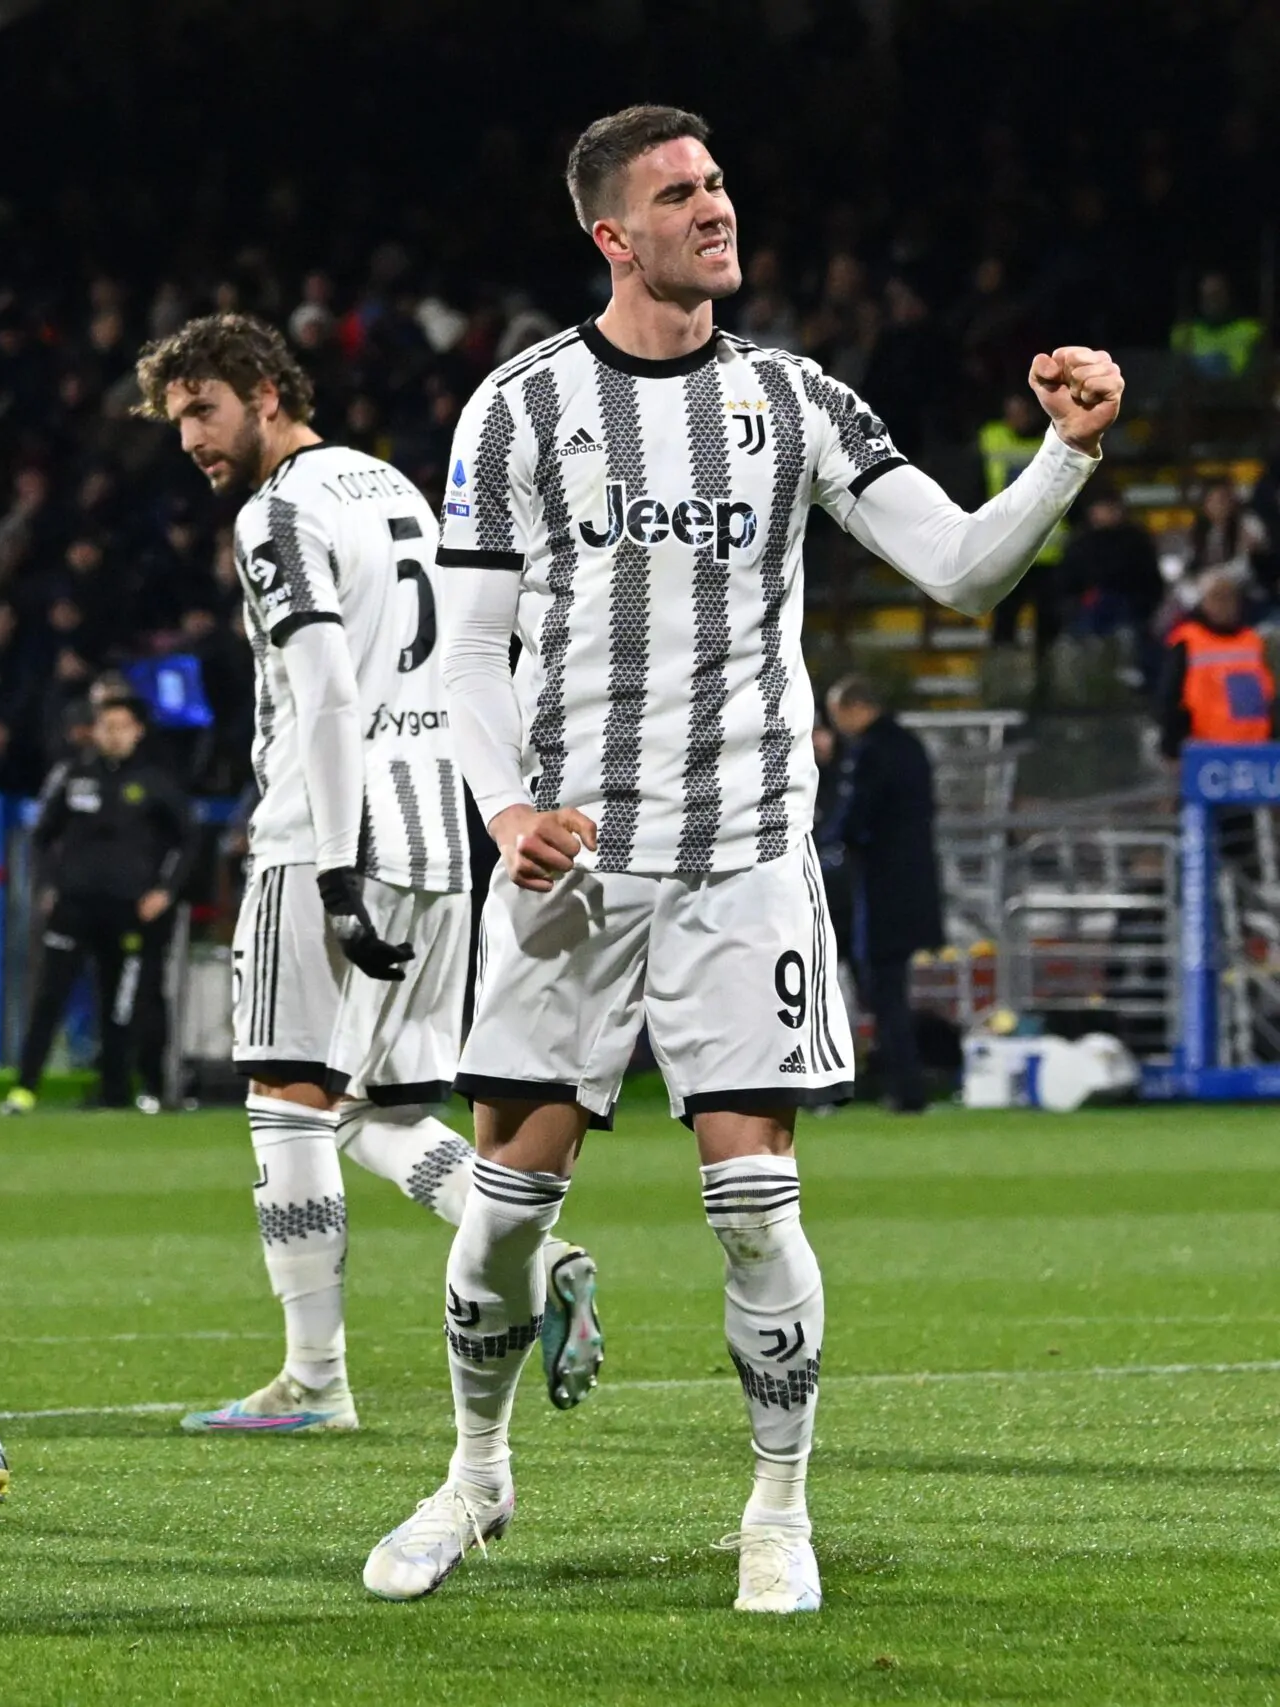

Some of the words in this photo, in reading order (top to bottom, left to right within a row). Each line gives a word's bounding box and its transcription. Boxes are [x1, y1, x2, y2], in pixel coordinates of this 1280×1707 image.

[560, 443, 603, 457] adidas
[573, 480, 761, 563] Jeep
[387, 516, 438, 674] 5
[775, 949, 807, 1029] 9
